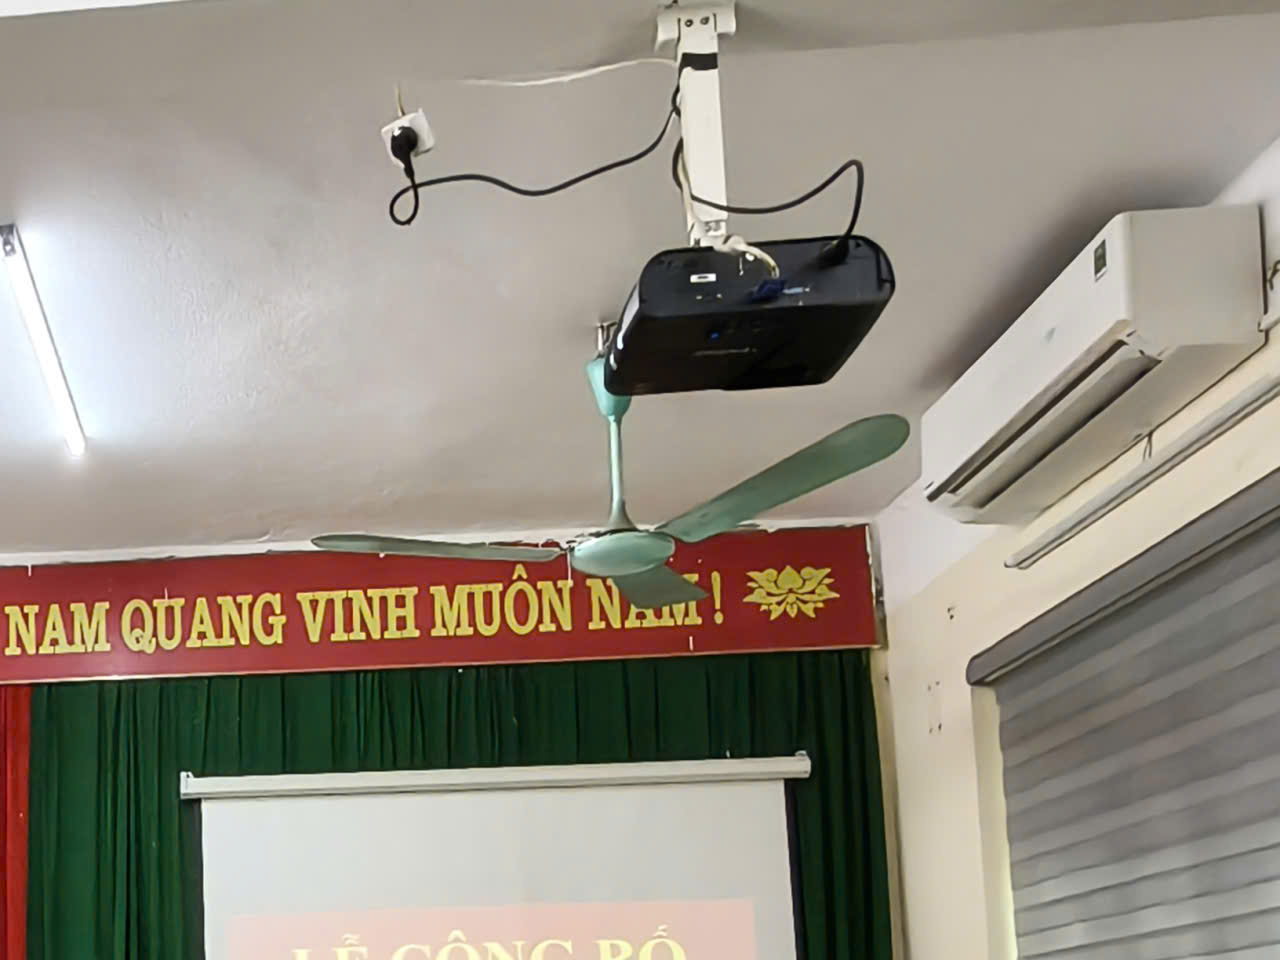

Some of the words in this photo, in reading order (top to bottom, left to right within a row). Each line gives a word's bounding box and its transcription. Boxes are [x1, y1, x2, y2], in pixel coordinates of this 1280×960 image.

[4, 600, 111, 655] NAM
[121, 592, 287, 654] QUANG
[297, 586, 420, 642] VINH
[431, 564, 573, 636] MUÔN
